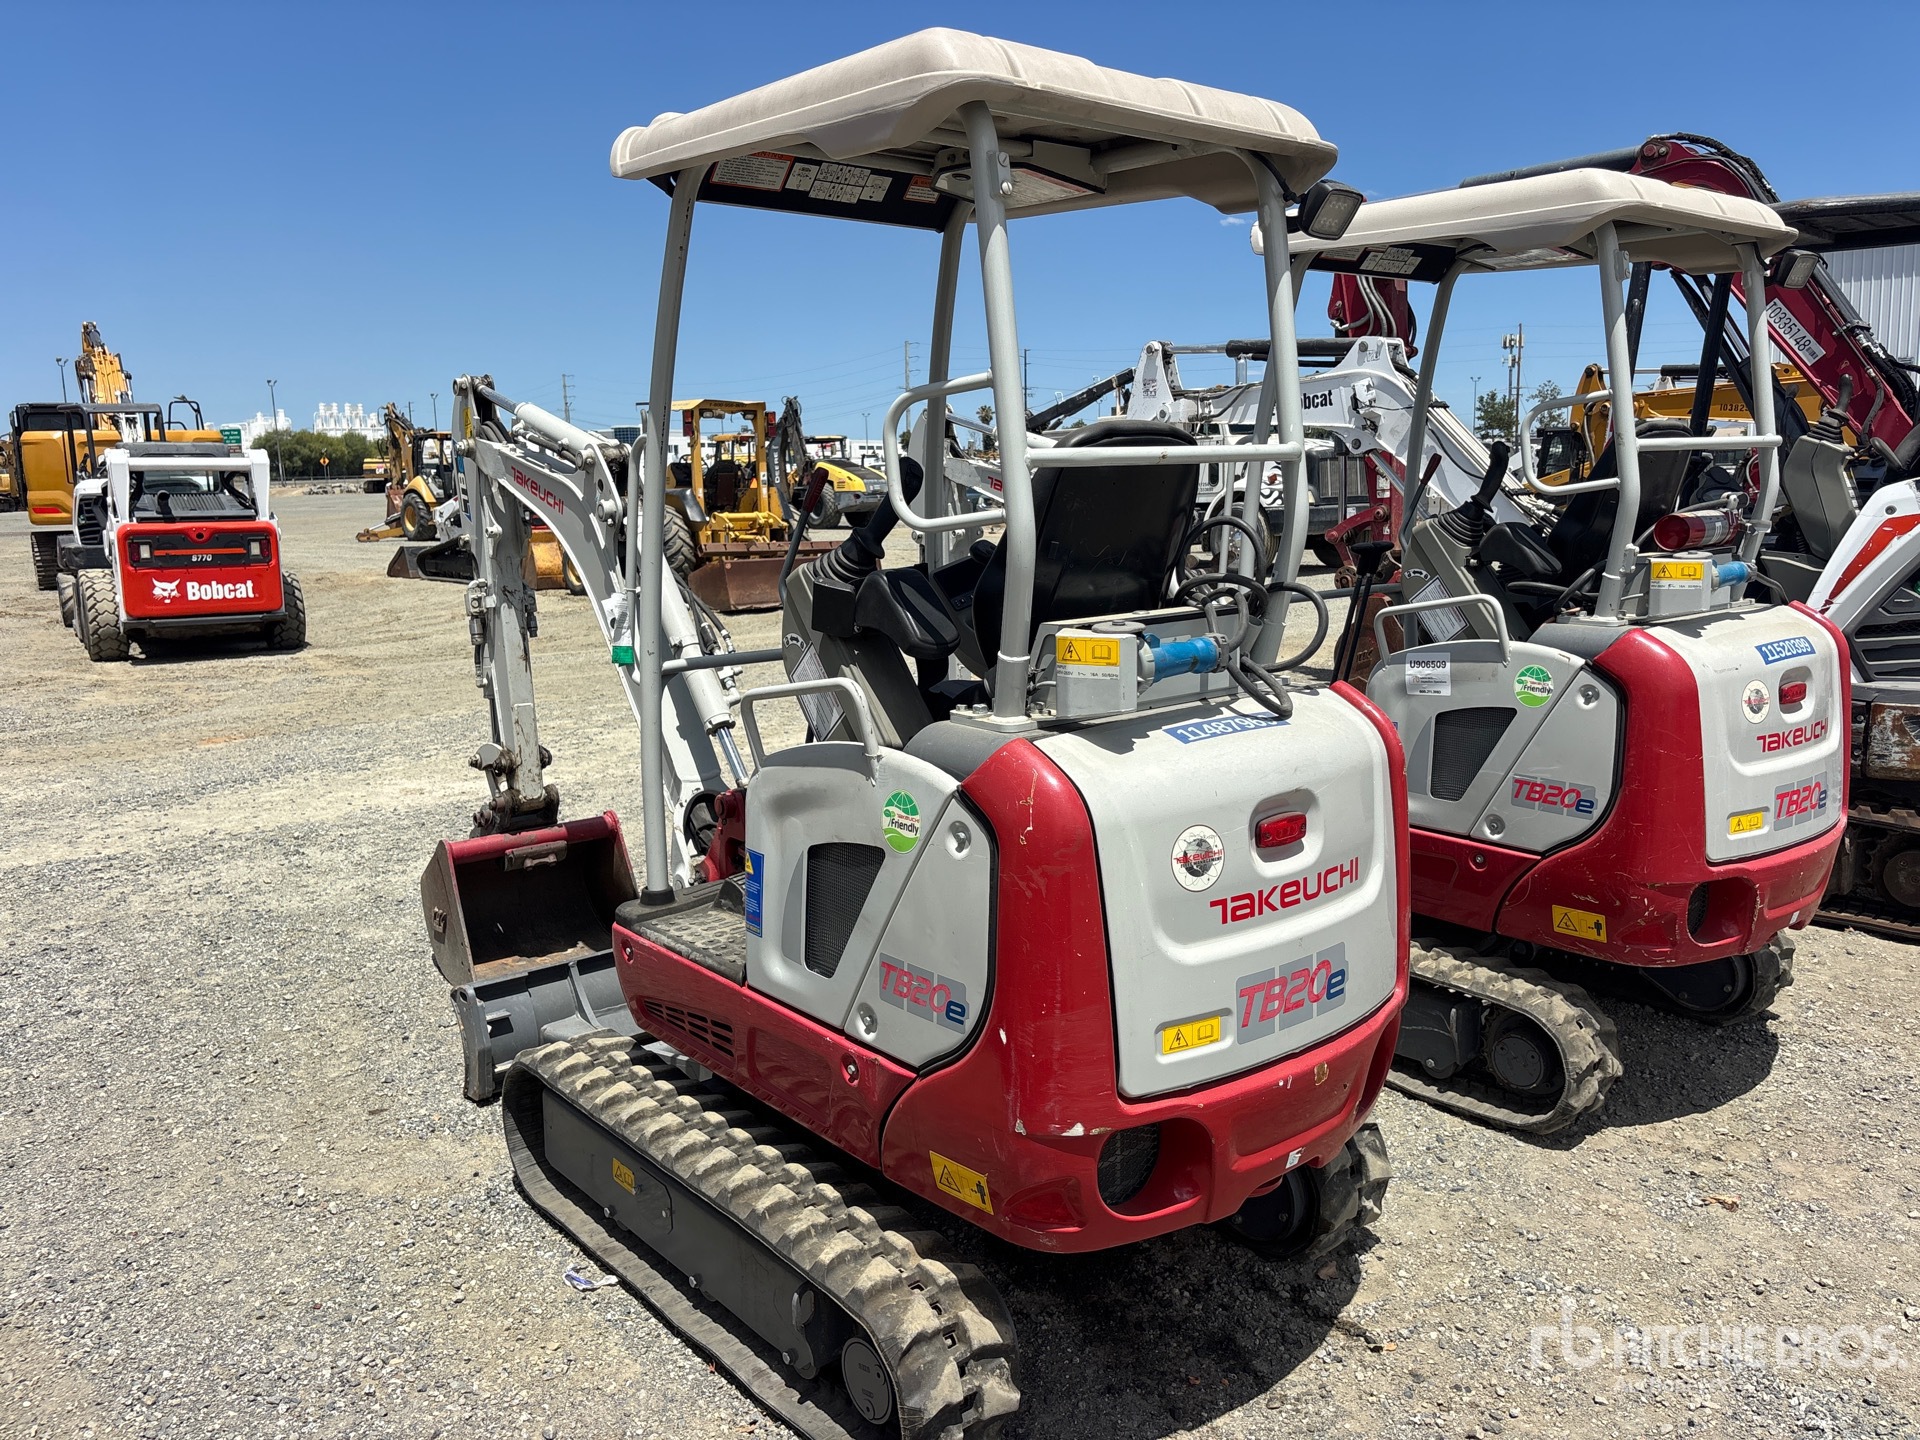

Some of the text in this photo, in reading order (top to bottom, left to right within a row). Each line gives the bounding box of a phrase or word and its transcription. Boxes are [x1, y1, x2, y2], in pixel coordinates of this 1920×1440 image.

[1765, 301, 1812, 352] T0335148
[511, 465, 565, 516] TAKEUCHI
[191, 554, 212, 562] S770
[186, 580, 254, 601] Bobcat
[1409, 660, 1447, 669] U906509
[1761, 638, 1812, 661] 11520399
[1756, 717, 1829, 753] TAKEUCHI
[1513, 779, 1595, 815] TB20e
[1776, 781, 1828, 820] TB20e
[890, 818, 919, 837] Friendly
[1173, 848, 1224, 865] TAKEUCHI
[1209, 856, 1359, 925] TAKEUCHI
[880, 961, 966, 1026] TB20e
[1239, 959, 1346, 1029] TB20e
